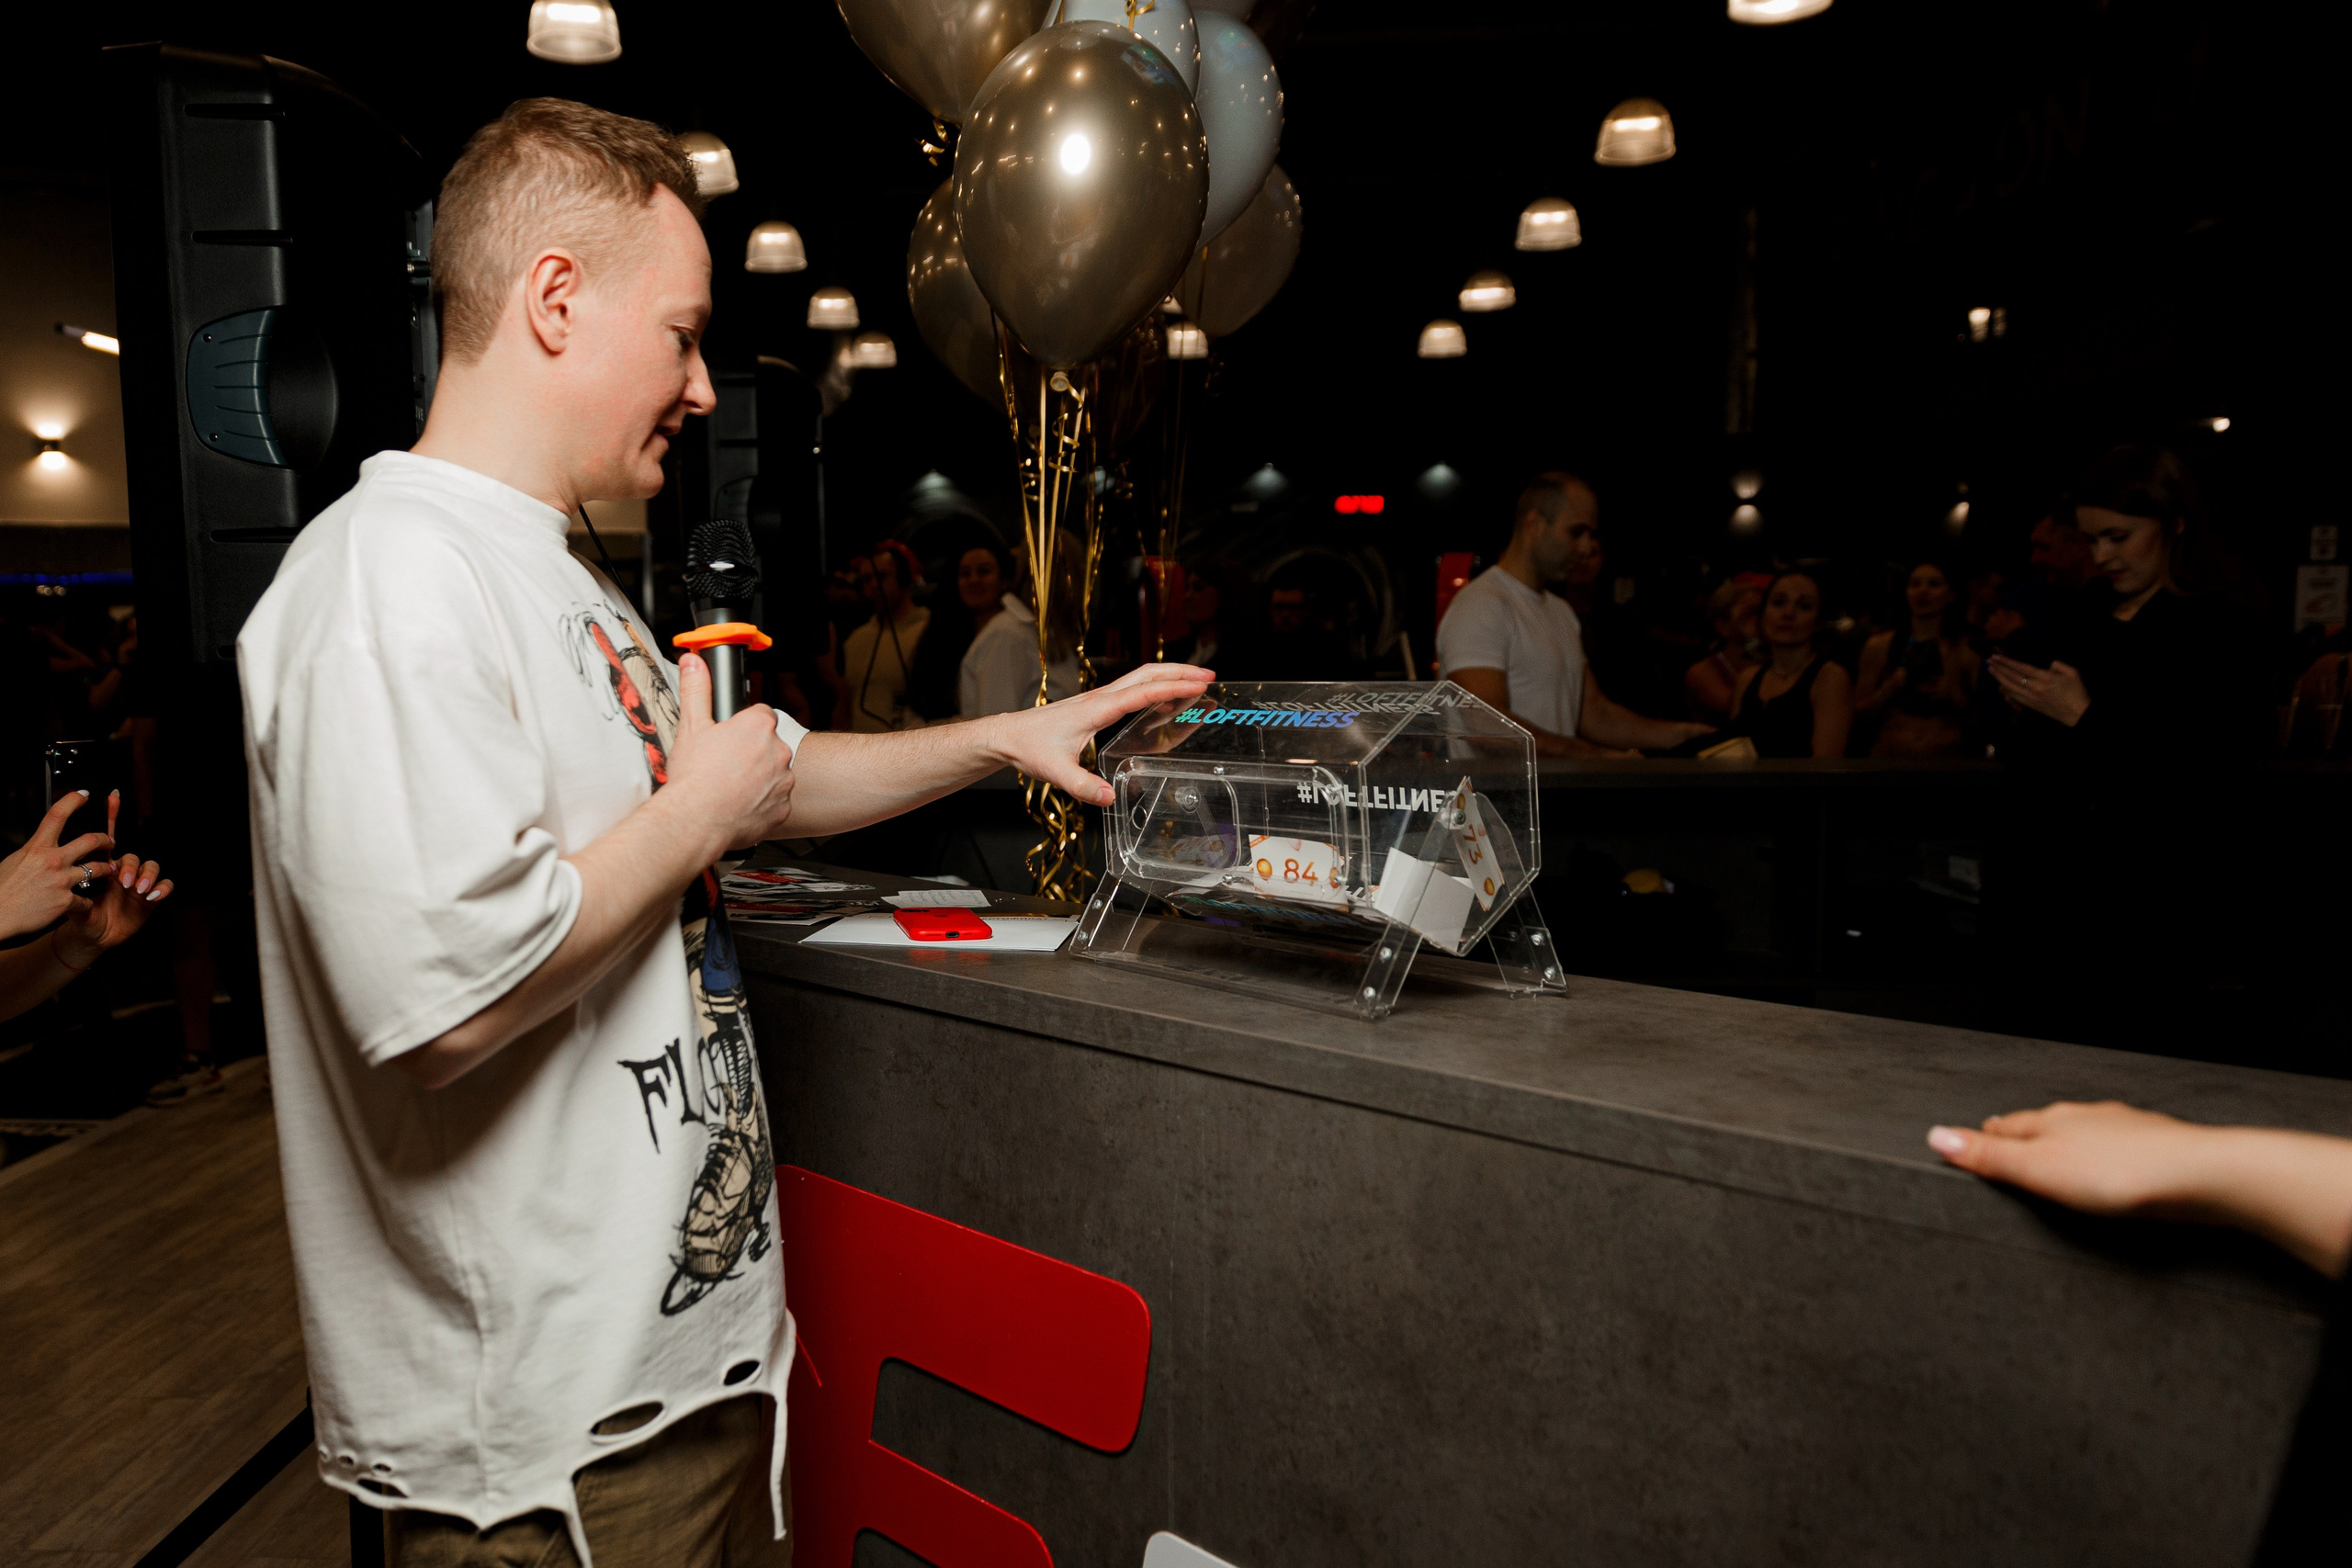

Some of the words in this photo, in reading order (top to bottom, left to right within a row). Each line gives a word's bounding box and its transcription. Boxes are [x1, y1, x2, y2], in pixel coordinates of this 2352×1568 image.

[1174, 707, 1360, 728] #LOFTFITNESS
[1463, 823, 1483, 865] 73
[1283, 857, 1318, 886] 84
